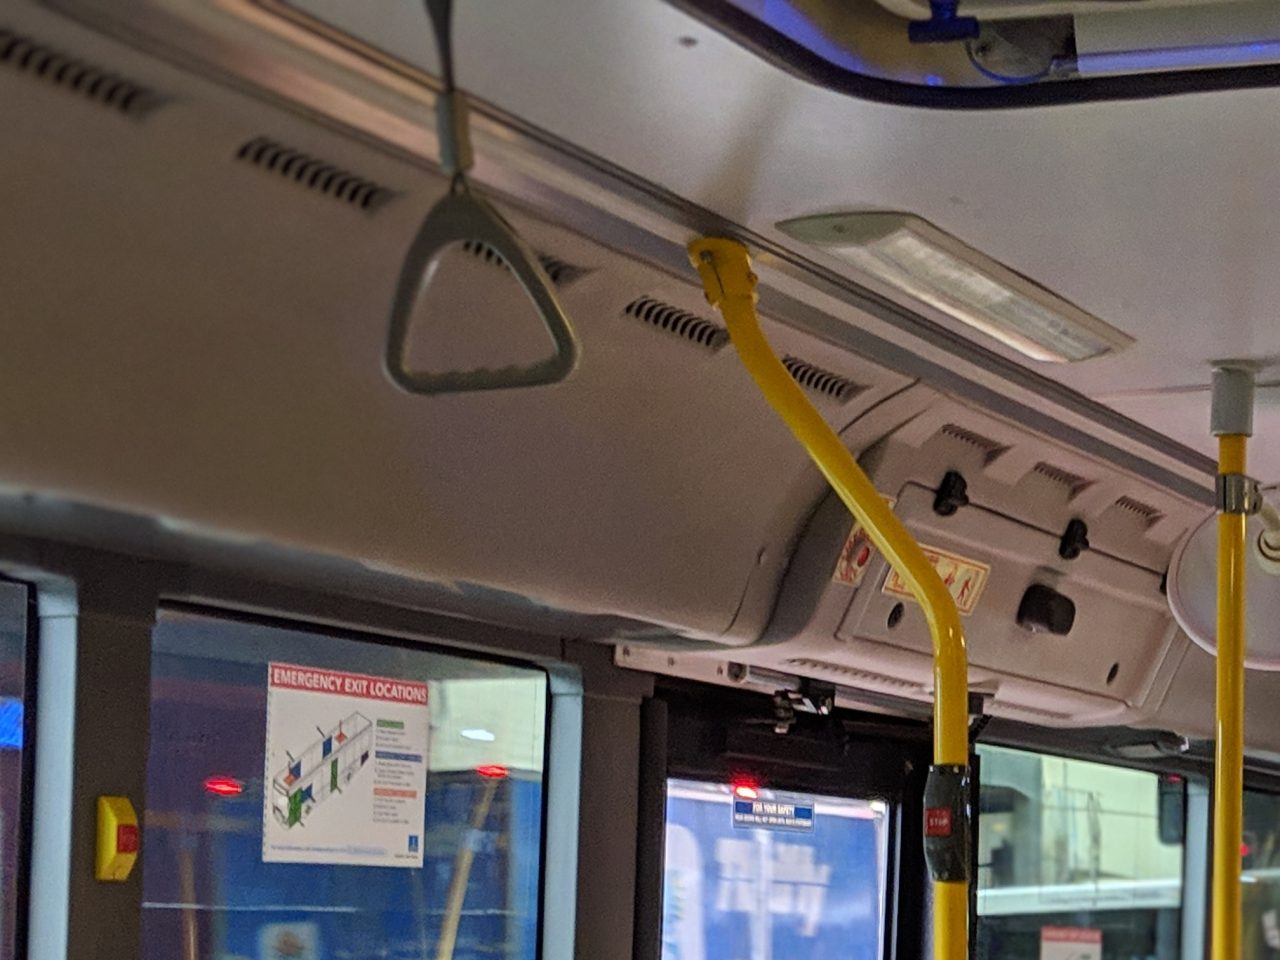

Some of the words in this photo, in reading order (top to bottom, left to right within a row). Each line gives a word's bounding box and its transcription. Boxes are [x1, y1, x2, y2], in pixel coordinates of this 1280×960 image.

[273, 669, 341, 691] EMERGENCY
[345, 679, 368, 694] EXIT
[370, 682, 427, 702] LOCATIONS
